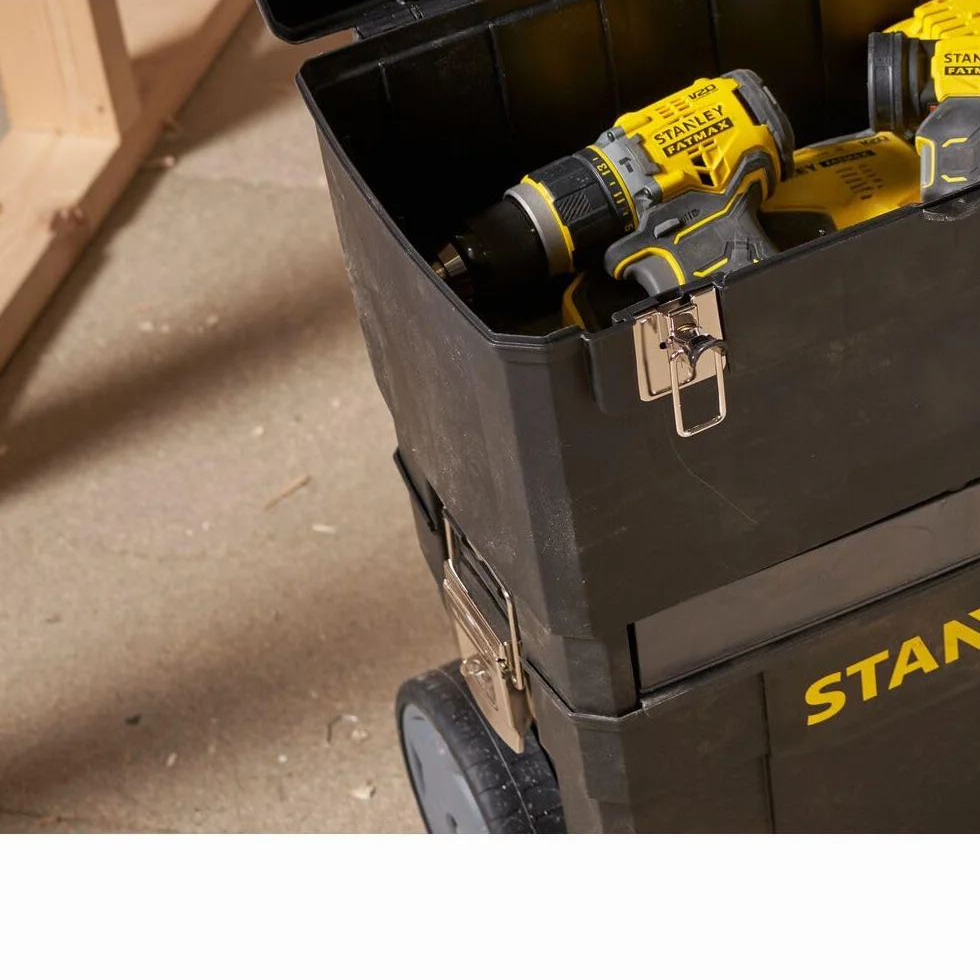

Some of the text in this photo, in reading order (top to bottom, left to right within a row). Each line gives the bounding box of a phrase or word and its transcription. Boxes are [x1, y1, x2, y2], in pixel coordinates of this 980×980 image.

[687, 83, 717, 101] V20
[653, 105, 725, 146] STANLEY
[667, 120, 731, 156] FATMAX
